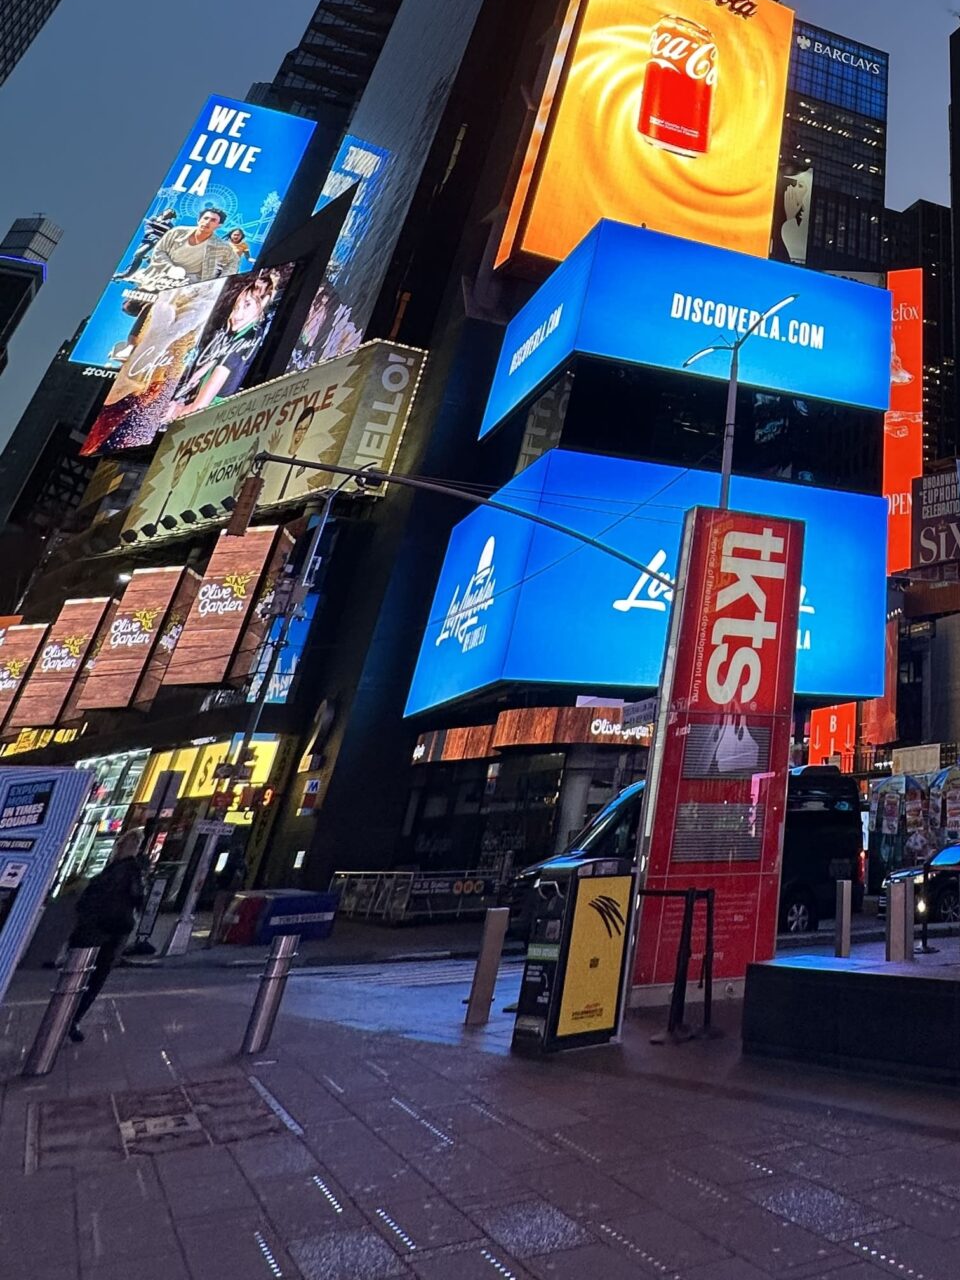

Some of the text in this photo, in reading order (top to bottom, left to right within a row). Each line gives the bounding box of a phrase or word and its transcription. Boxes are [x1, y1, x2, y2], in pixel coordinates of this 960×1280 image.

[814, 41, 880, 75] BARCLAYS
[207, 104, 251, 138] WE
[189, 133, 262, 174] LOVE
[172, 163, 212, 197] LA
[670, 292, 824, 350] DISCOVERLA.COM
[214, 378, 310, 425] MUSICAL THEATER
[173, 384, 338, 462] MISSIONARY STYLE
[205, 460, 248, 487] MORM
[199, 584, 231, 600] Olive
[199, 598, 243, 617] Garden
[705, 527, 786, 705] tkts
[111, 619, 140, 634] Olive
[42, 644, 68, 659] Olive
[110, 630, 151, 649] Garden
[694, 614, 710, 677] development
[41, 656, 76, 672] Garden
[691, 679, 702, 703] fund
[590, 718, 622, 736] Olive
[9, 781, 53, 797] EXPLORE
[0, 814, 40, 830] SQUARE
[2, 802, 45, 818] IN TIMES
